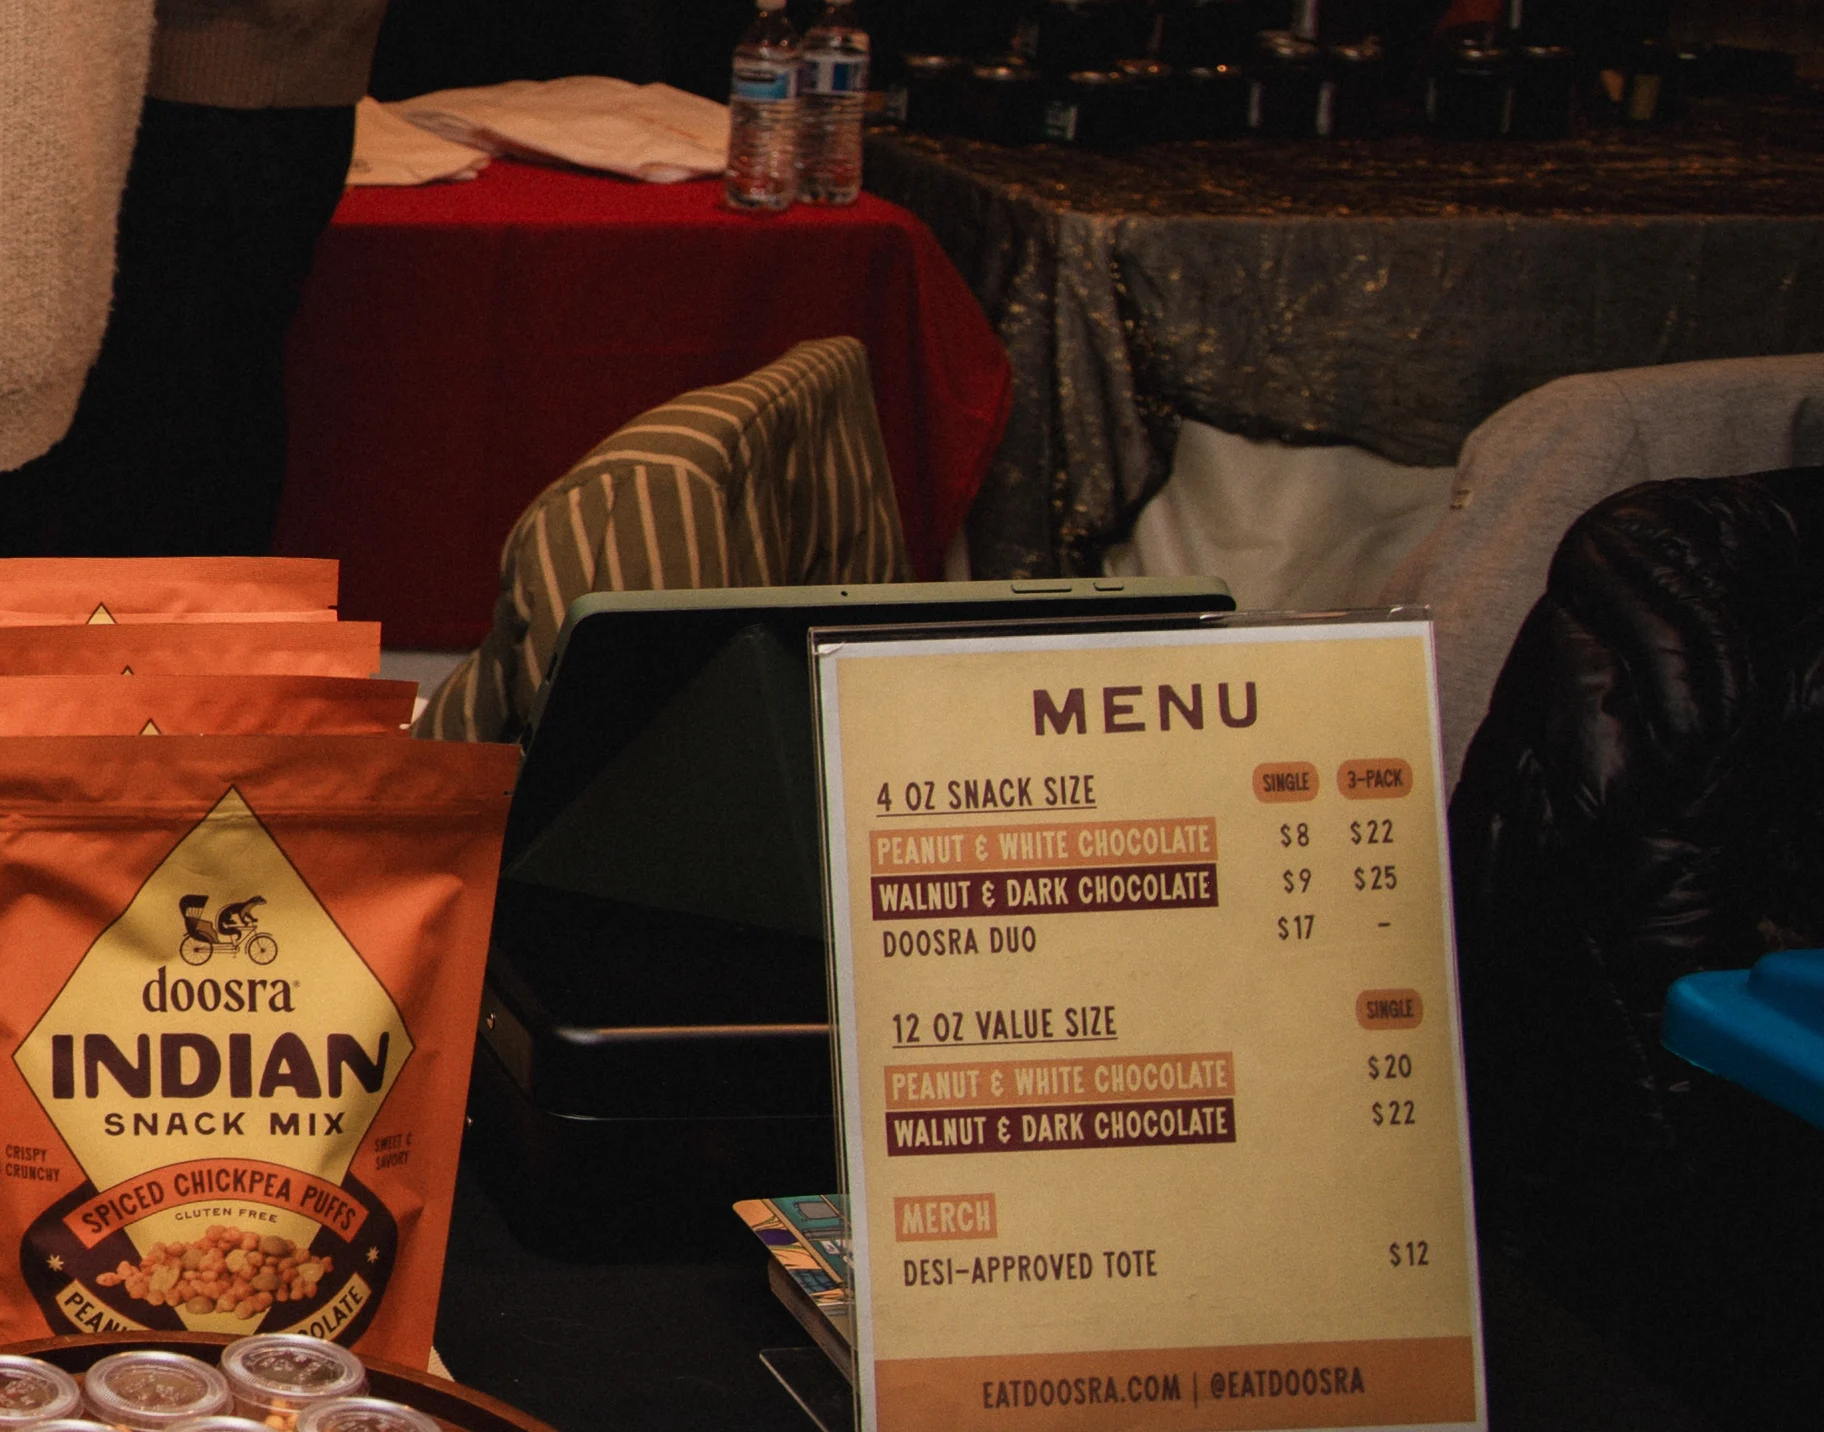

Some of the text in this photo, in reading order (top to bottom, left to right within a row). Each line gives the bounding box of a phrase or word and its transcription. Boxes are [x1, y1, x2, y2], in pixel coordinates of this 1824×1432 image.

[1033, 682, 1257, 735] MENU
[878, 775, 1095, 811] 4 OZ SNACK SIZE
[1263, 773, 1309, 792] SINGLE
[1348, 769, 1403, 789] 3-PACK
[878, 826, 1209, 865] PEANUT & WHITE CHOCOLATE
[1281, 823, 1309, 847] $8
[1351, 819, 1393, 845] $22
[879, 872, 1210, 911] WALNUT & DARK CHOCOLATE
[1283, 869, 1311, 893] $9
[1355, 866, 1397, 891] $25
[883, 926, 1036, 957] DOOSRA DUO
[1278, 915, 1314, 940] $17
[1367, 998, 1414, 1019] SINGLE
[893, 1006, 1116, 1043] 12 OZ VALUE SIZE
[51, 1031, 391, 1100] INDIAN
[893, 1060, 1226, 1100] PEANUT & WHITE CHOCOLATE
[1368, 1054, 1411, 1080] $20
[104, 1111, 346, 1137] SNACK MIX
[894, 1107, 1227, 1147] WALNUT & DARK CHOCOLATE
[1372, 1100, 1415, 1126] $22
[82, 1168, 356, 1234] SPICED CHICKPEA PUFFS
[903, 1201, 990, 1234] MERCH
[904, 1250, 1157, 1286] DESI-APPROVED TOTE
[1390, 1241, 1428, 1267] $12
[983, 1366, 1365, 1408] EATDOOSRA.COM @EATDOOSRA
